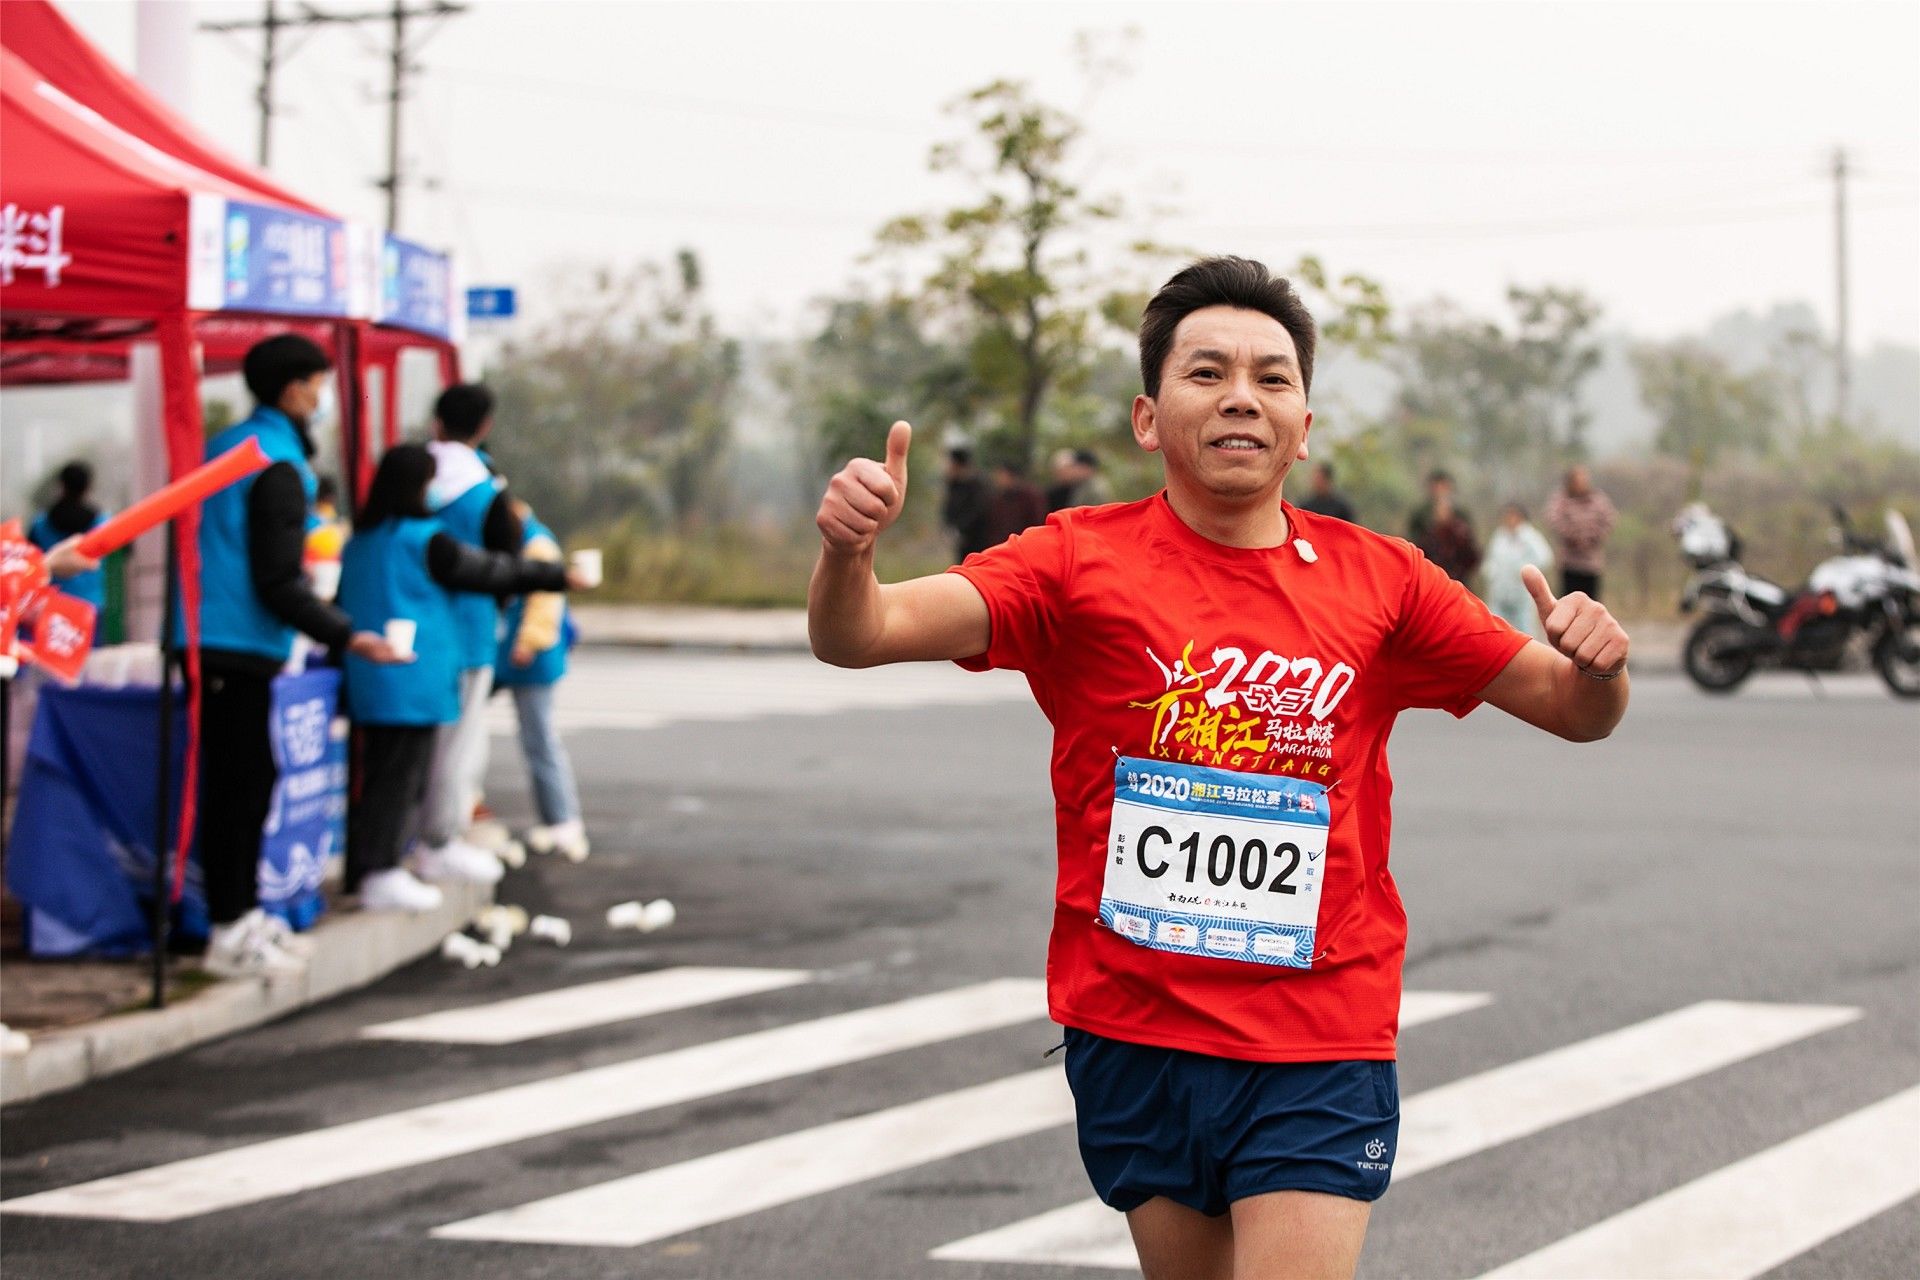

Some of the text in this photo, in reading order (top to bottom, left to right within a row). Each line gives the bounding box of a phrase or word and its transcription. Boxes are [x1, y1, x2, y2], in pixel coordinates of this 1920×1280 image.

[1205, 646, 1355, 721] 2020
[1175, 701, 1335, 753] 湘江 马拉松赛
[1270, 741, 1332, 759] MARATHON
[1159, 745, 1332, 776] XIANGJIANG
[1136, 825, 1301, 895] C1002
